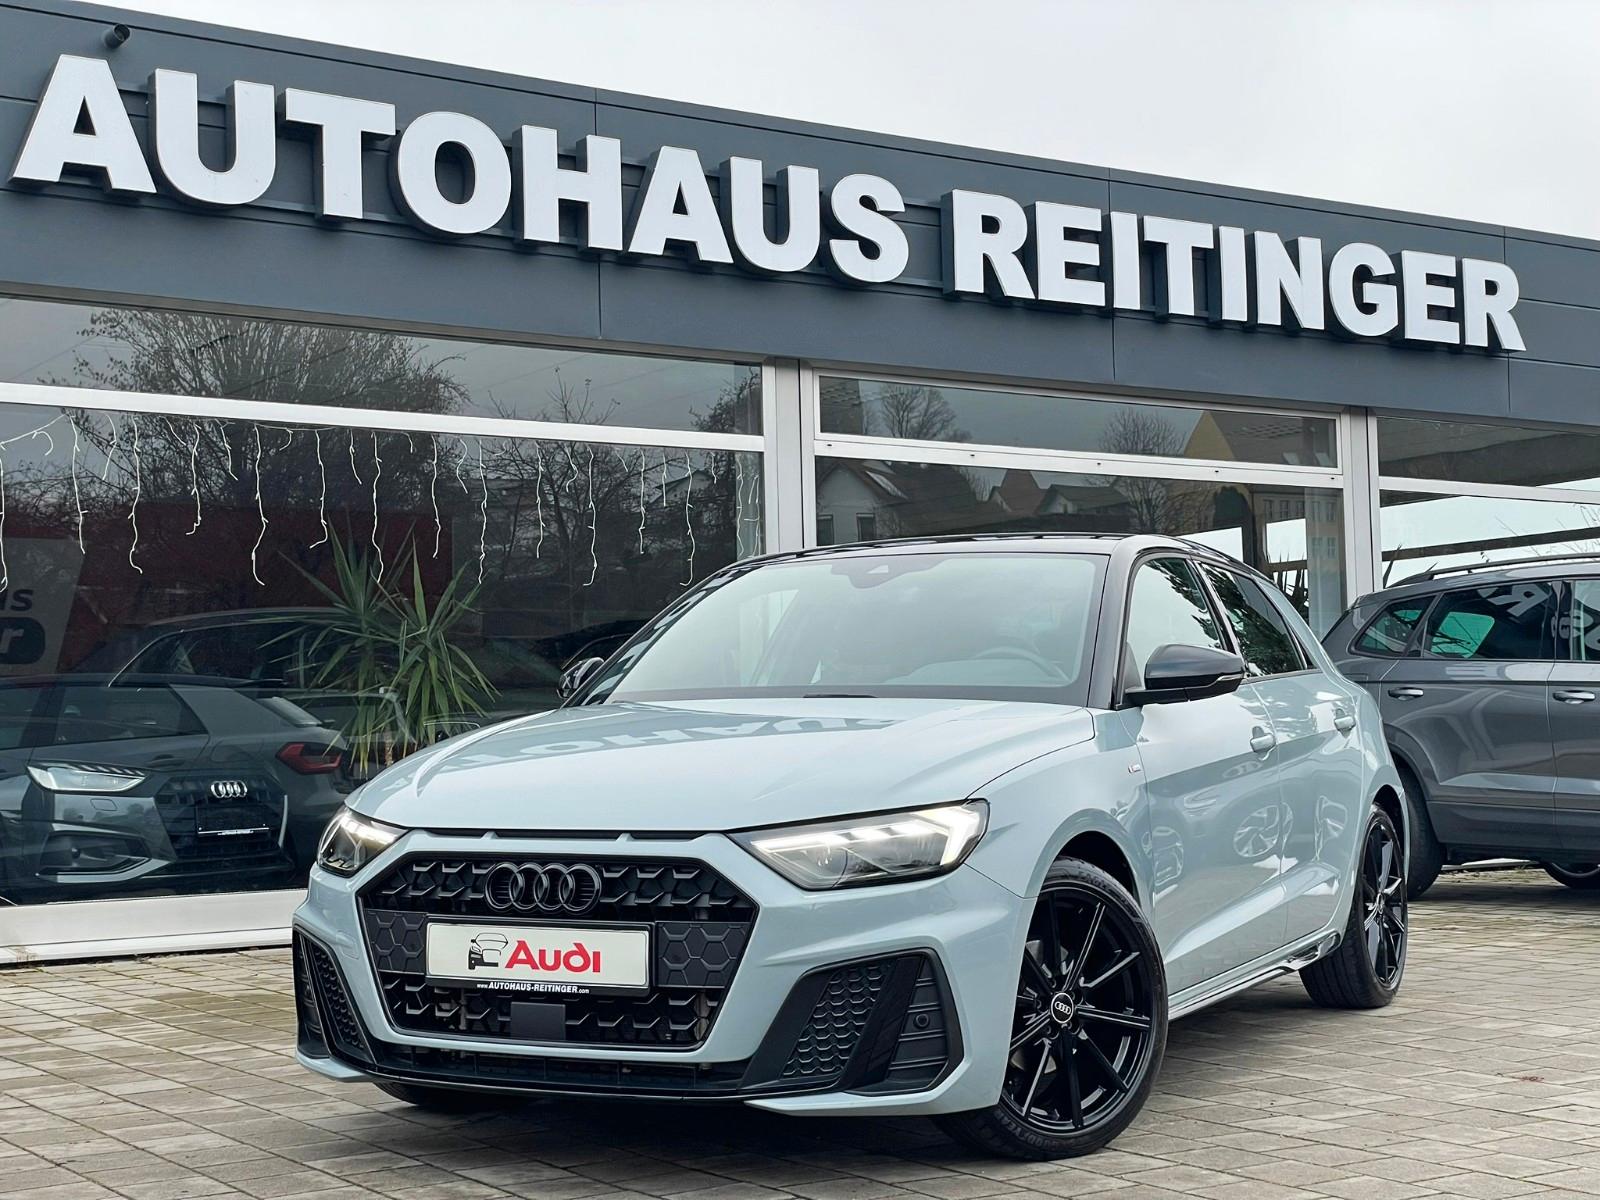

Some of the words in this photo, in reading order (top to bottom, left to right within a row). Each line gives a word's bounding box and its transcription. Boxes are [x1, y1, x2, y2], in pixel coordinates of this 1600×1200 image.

[11, 54, 909, 284] AUTOHAUS
[952, 189, 1527, 351] REITINGER
[505, 940, 601, 973] Audi
